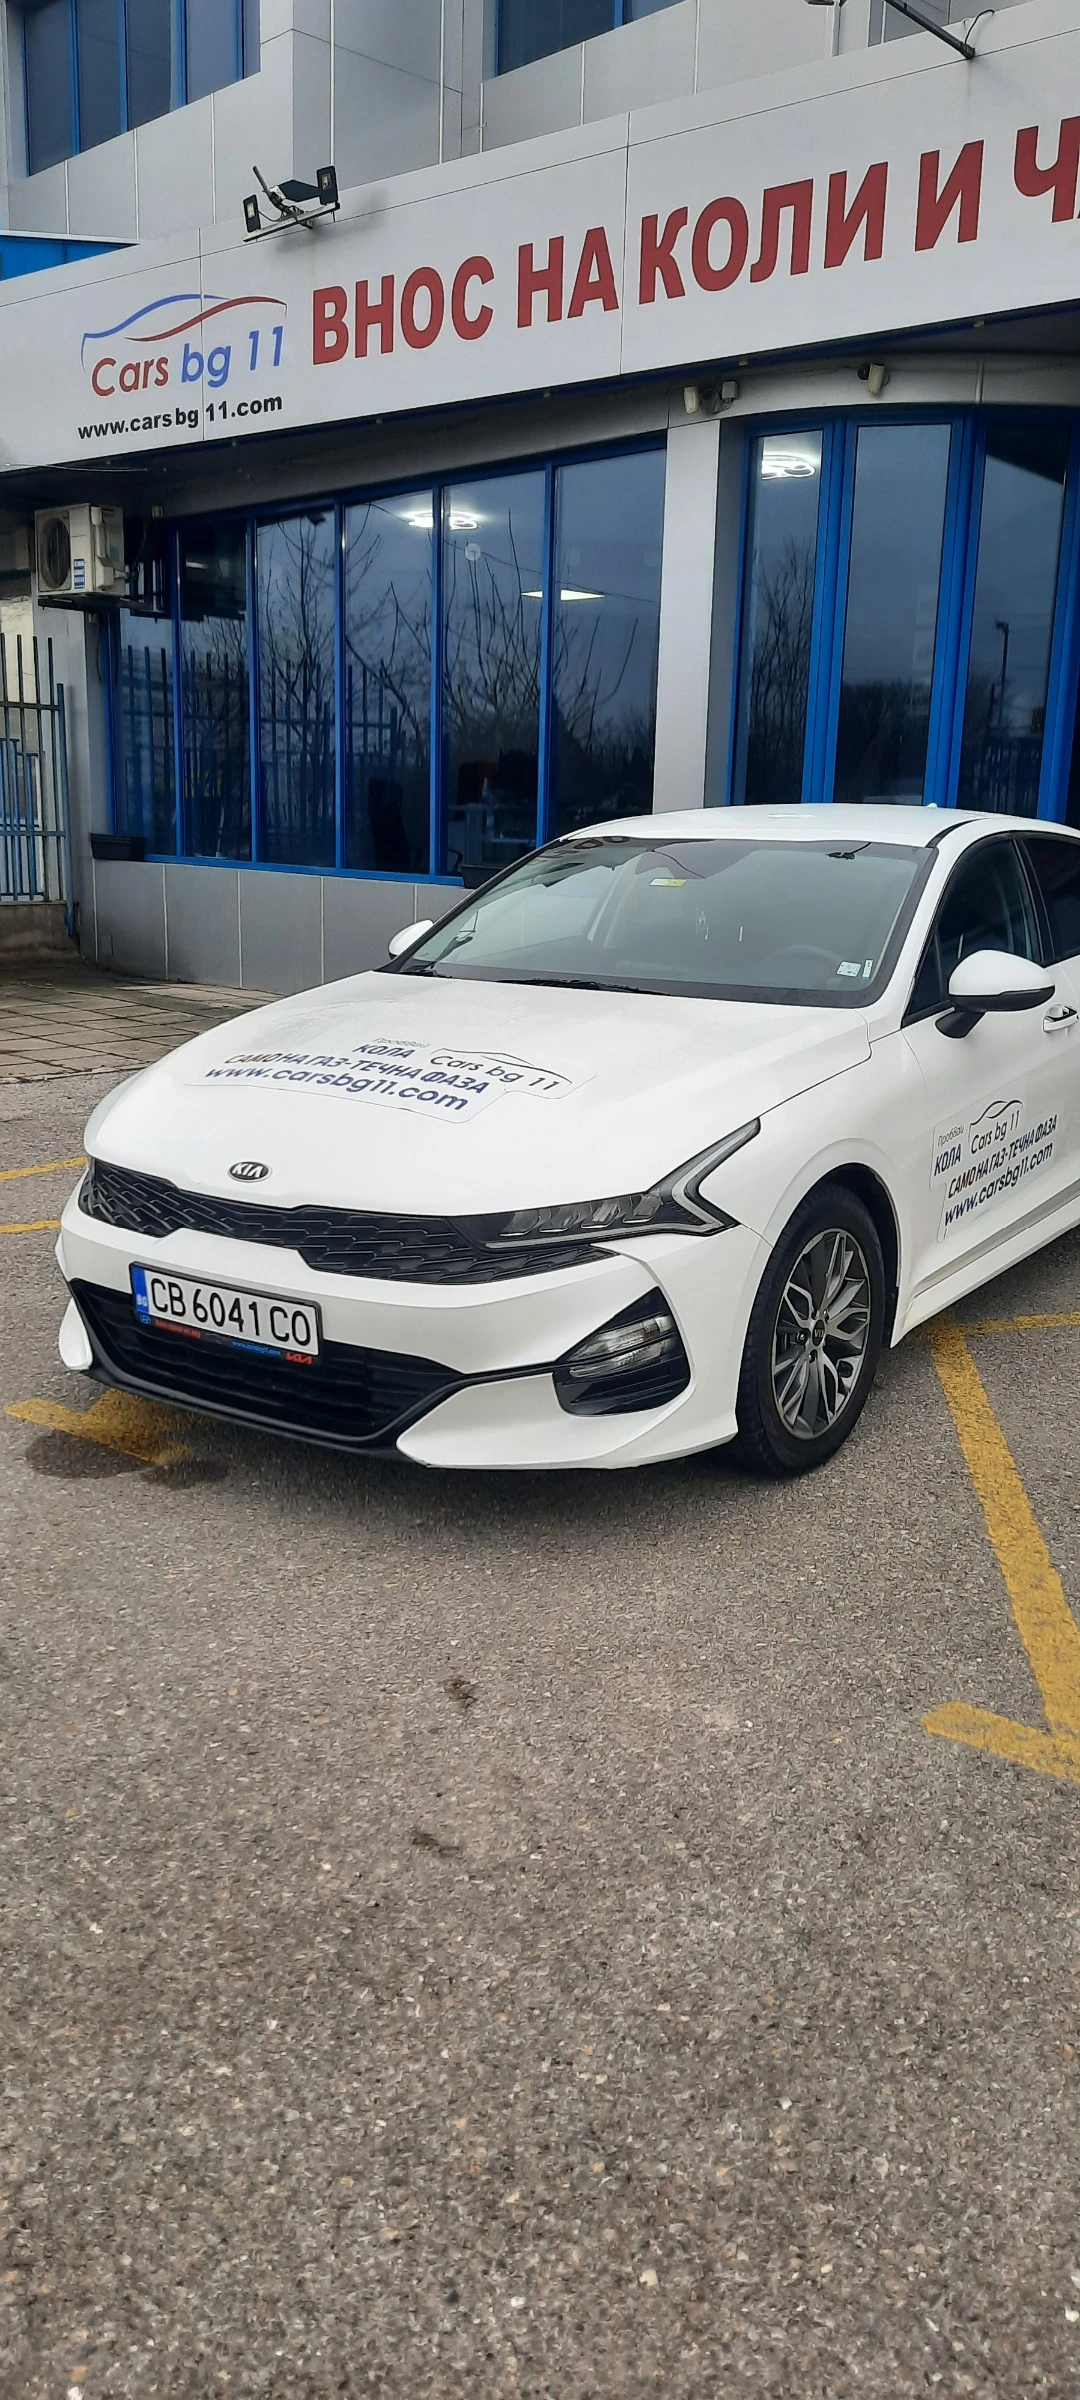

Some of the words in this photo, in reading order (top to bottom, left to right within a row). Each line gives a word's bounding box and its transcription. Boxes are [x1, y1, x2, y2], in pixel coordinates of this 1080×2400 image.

[312, 255, 495, 366] ВНОС
[517, 226, 620, 329] НА
[638, 161, 889, 306] КОЛИ
[914, 139, 985, 252] И
[1013, 115, 1080, 224] Ч
[91, 356, 169, 397] Cars
[180, 343, 232, 388] bg
[248, 325, 284, 371] 11
[352, 1043, 416, 1059] КОЛА
[430, 1055, 484, 1071] Cars
[485, 1065, 525, 1083] bg
[528, 1077, 560, 1090] 11
[205, 1067, 469, 1111] www.carsbg11.com
[970, 1130, 993, 1155] Cars
[993, 1121, 1008, 1142] bg
[1010, 1110, 1019, 1131] 11
[231, 1162, 264, 1179] KIA
[934, 1143, 962, 1177] КОЛА
[944, 1142, 1054, 1227] www.carsbg11.com
[151, 1278, 186, 1316] CB
[193, 1288, 261, 1337] 6041
[269, 1305, 312, 1347] CO
